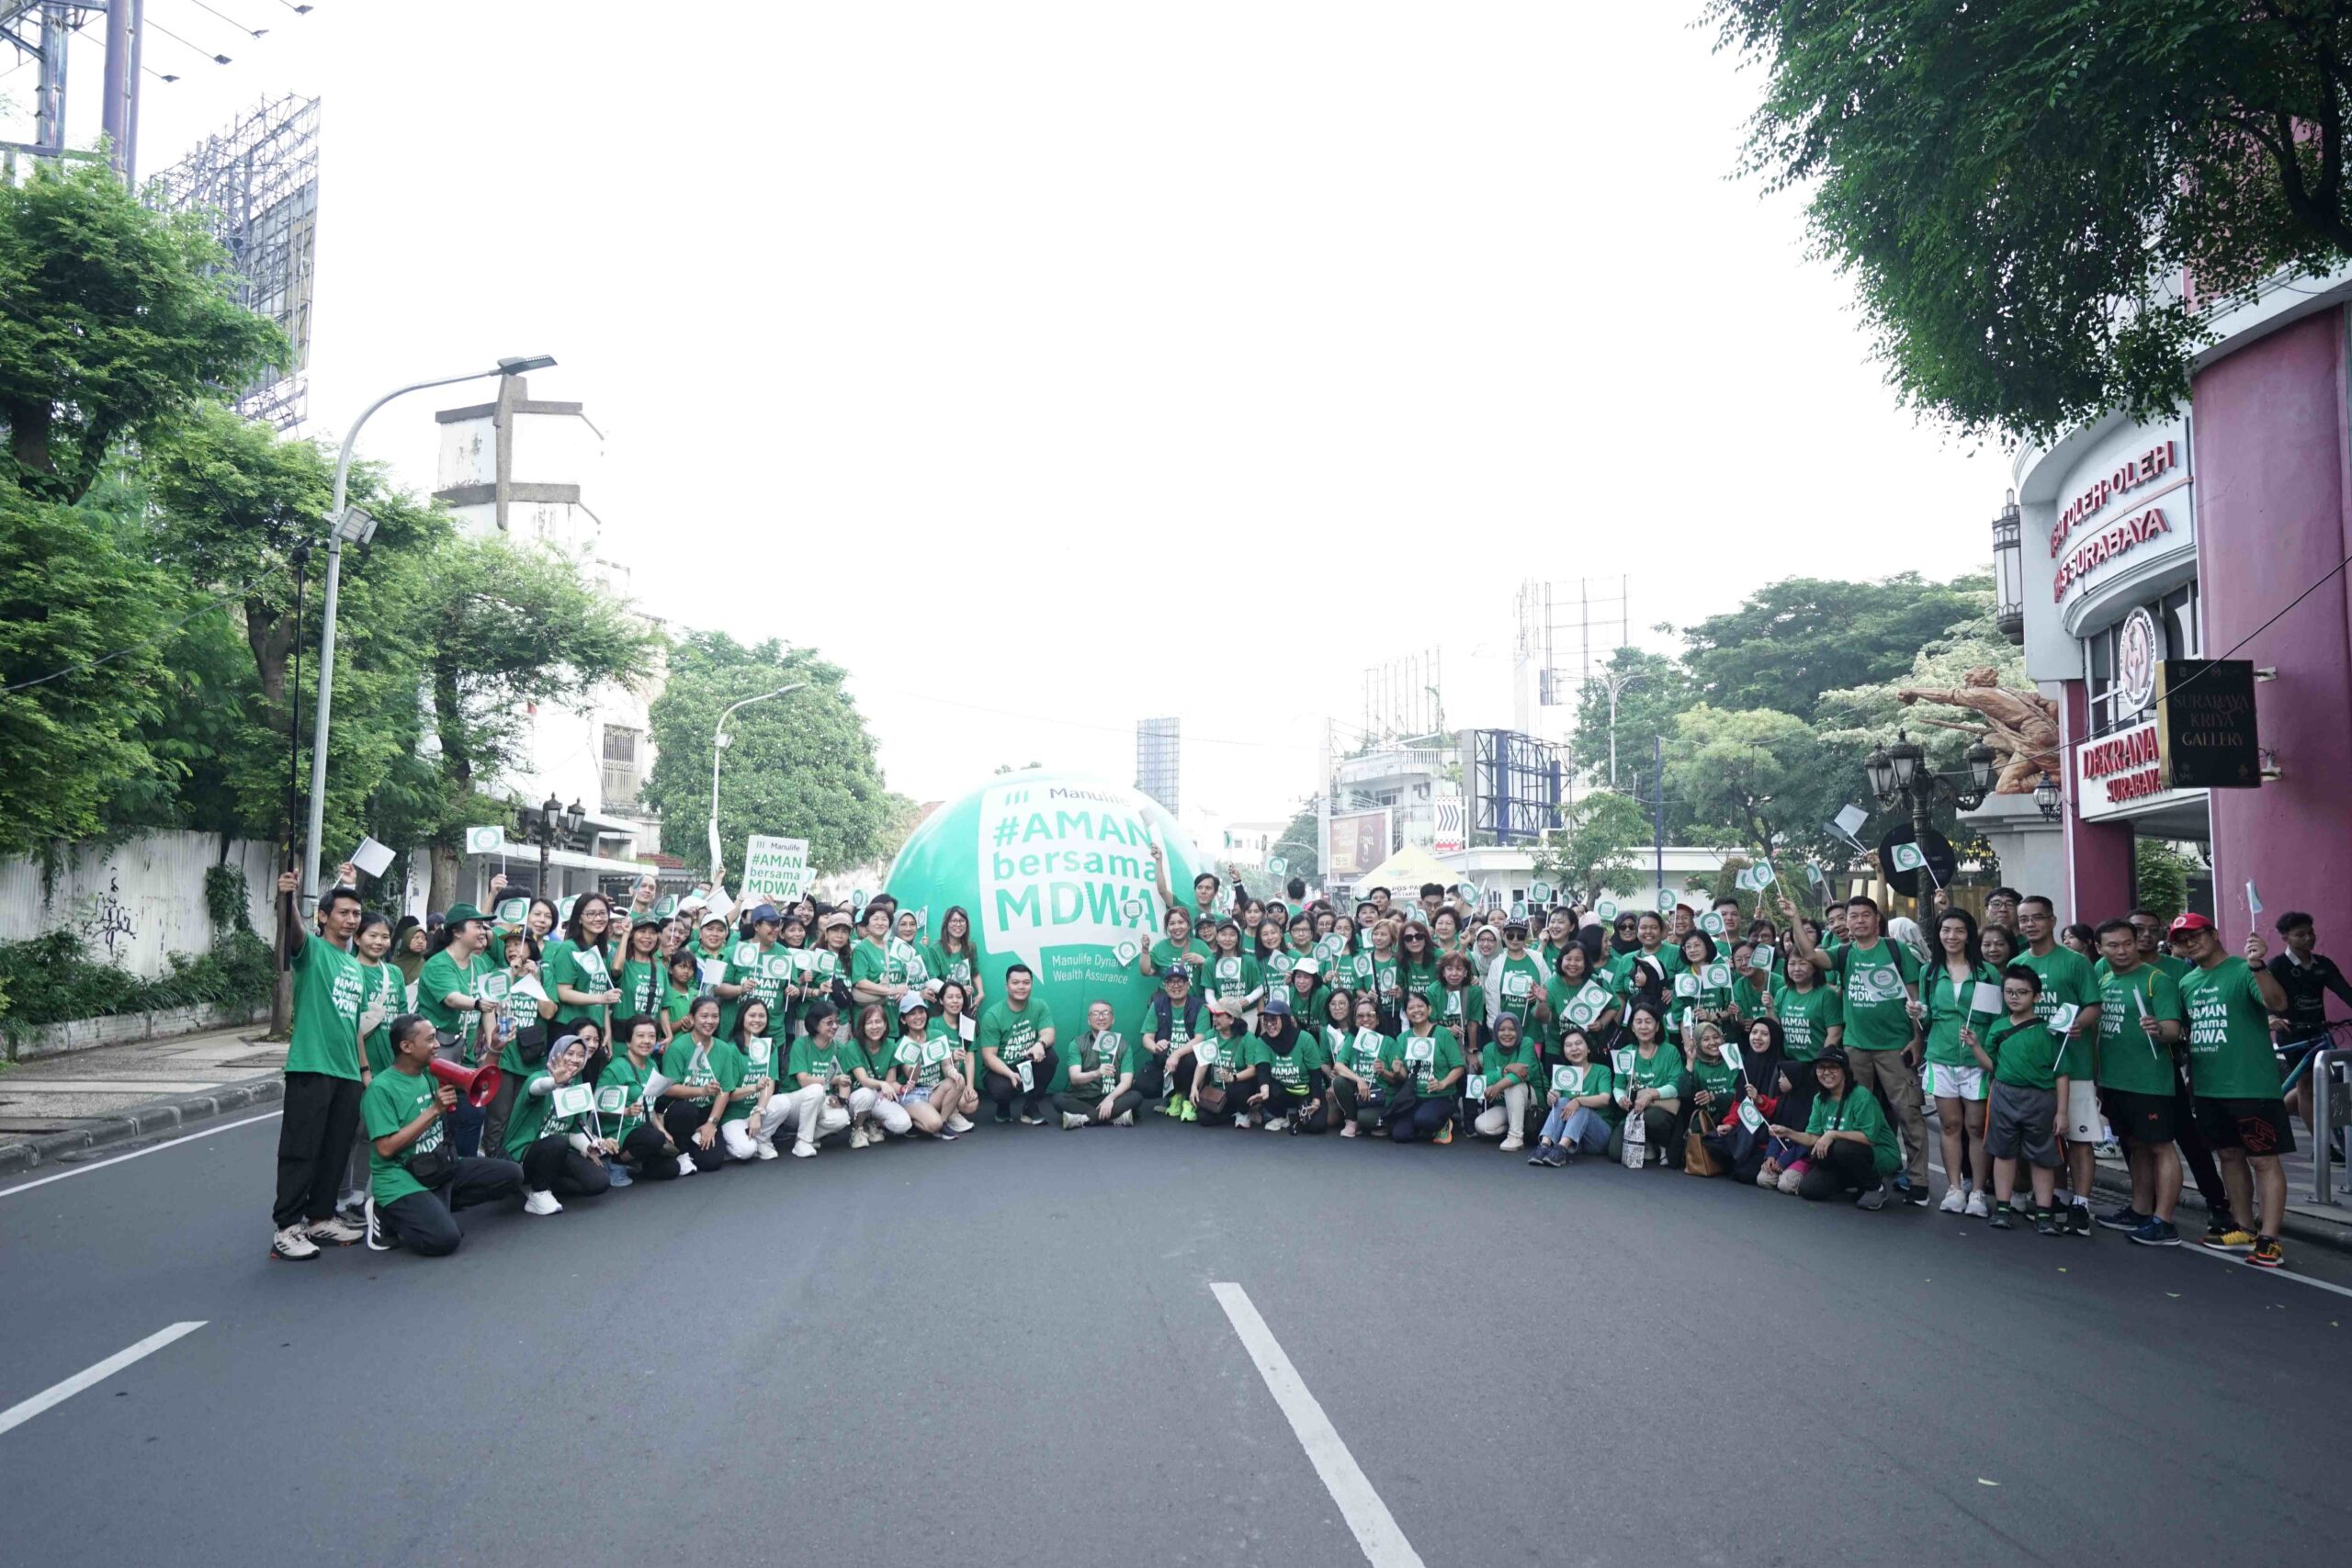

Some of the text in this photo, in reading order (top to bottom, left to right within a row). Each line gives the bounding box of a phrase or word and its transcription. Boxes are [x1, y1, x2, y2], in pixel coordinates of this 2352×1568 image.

[2067, 441, 2177, 527] OLEH-OLEH
[2069, 508, 2171, 581] SURABAYA
[2174, 694, 2249, 713] SURABAYA
[2190, 713, 2234, 728] KRIYA
[2182, 731, 2244, 746] GALLERY
[993, 810, 1153, 848] #AMAN
[771, 841, 800, 851] Manulife
[752, 853, 802, 868] #AMAN
[993, 850, 1158, 882] bersama
[750, 866, 800, 880] bersama
[748, 878, 797, 896] MDWA
[995, 881, 1158, 932] MDWA
[1052, 953, 1132, 970] Manulife Dynac
[1053, 969, 1128, 984] Wealth Assurance
[1848, 991, 1874, 1001] MDW
[2102, 1002, 2125, 1014] AMAN
[2100, 1021, 2120, 1033] DWA
[2191, 1019, 2227, 1029] rsama
